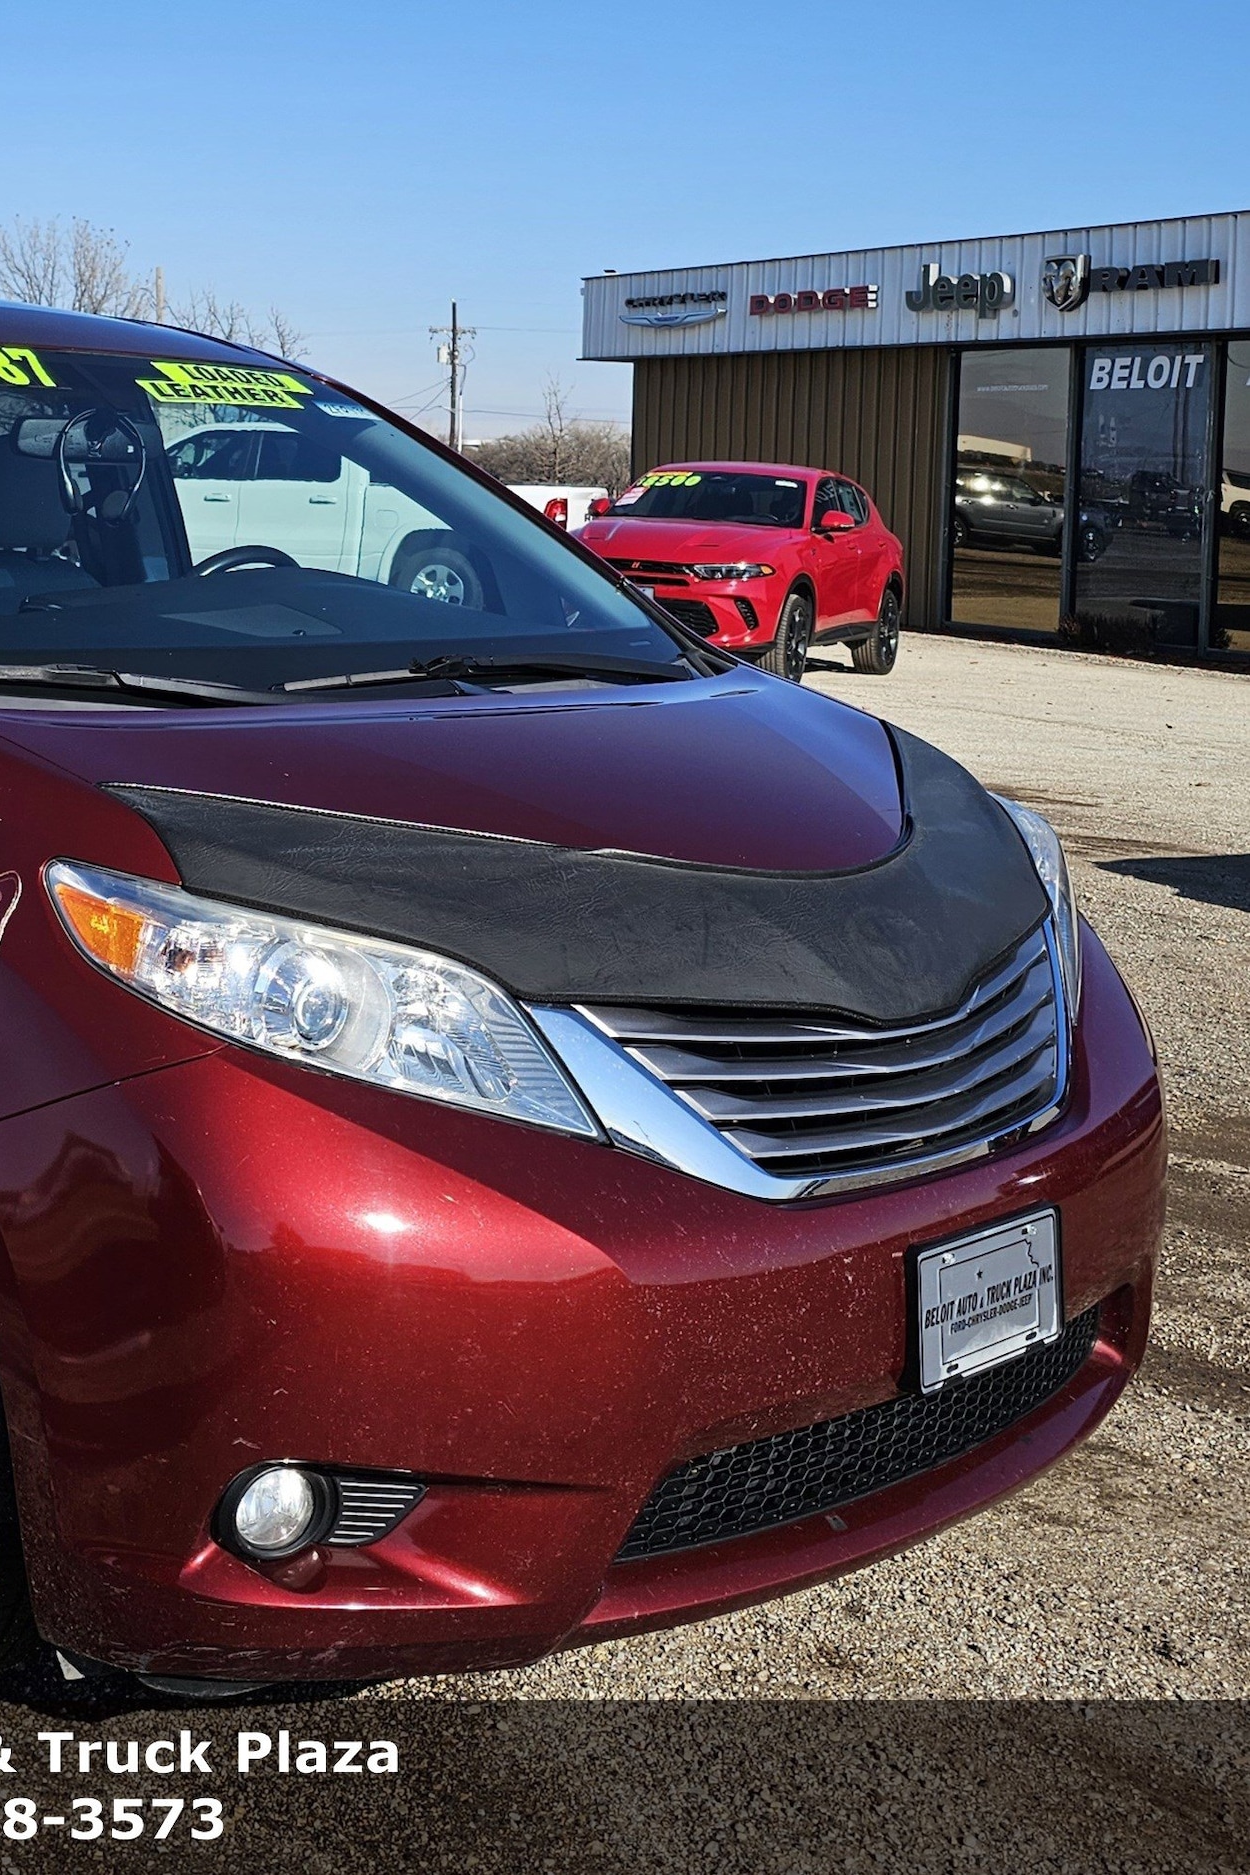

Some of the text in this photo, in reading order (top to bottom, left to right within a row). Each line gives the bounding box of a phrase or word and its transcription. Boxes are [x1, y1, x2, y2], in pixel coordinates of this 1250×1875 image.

[905, 263, 1015, 319] Jeep
[1090, 259, 1220, 292] RAM
[750, 285, 879, 315] DODGE
[178, 364, 286, 387] LOADED
[1090, 355, 1204, 389] BELOIT
[150, 380, 285, 403] LEATHER
[924, 1300, 955, 1330] BELOIT
[956, 1292, 978, 1318] AUTO
[986, 1279, 1012, 1305] TRUCK
[1013, 1270, 1037, 1296] PLAZA
[1038, 1264, 1054, 1286] INC.
